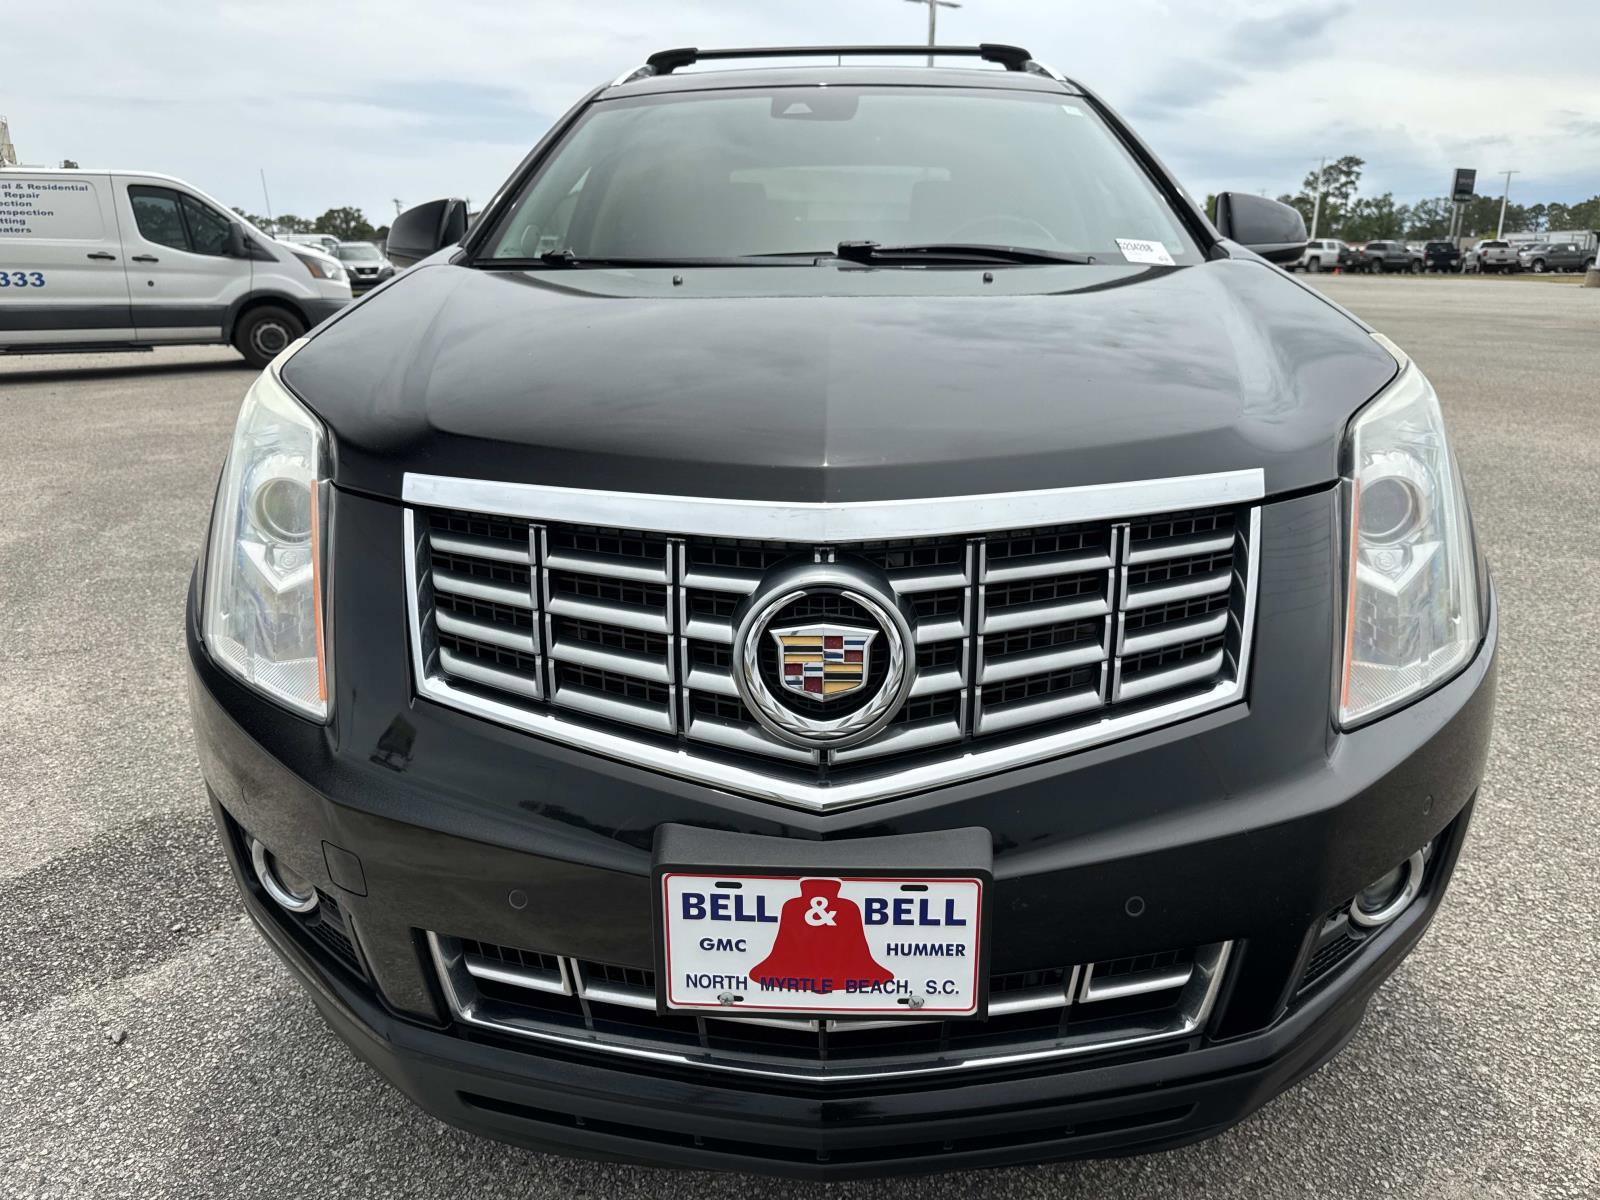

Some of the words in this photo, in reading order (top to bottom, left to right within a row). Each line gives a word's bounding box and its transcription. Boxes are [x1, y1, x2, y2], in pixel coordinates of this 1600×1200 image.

[4, 191, 41, 199] Repair
[27, 183, 88, 192] Residential
[0, 271, 46, 288] 333
[682, 892, 778, 924] BELL
[804, 896, 838, 927] &
[864, 897, 967, 927] BELL
[699, 937, 747, 953] GMC
[886, 942, 966, 957] HUMMER
[685, 973, 748, 991] NORTH
[760, 976, 833, 994] MYRTLE
[845, 979, 913, 997] BEACH,
[925, 979, 960, 995] S.C.
